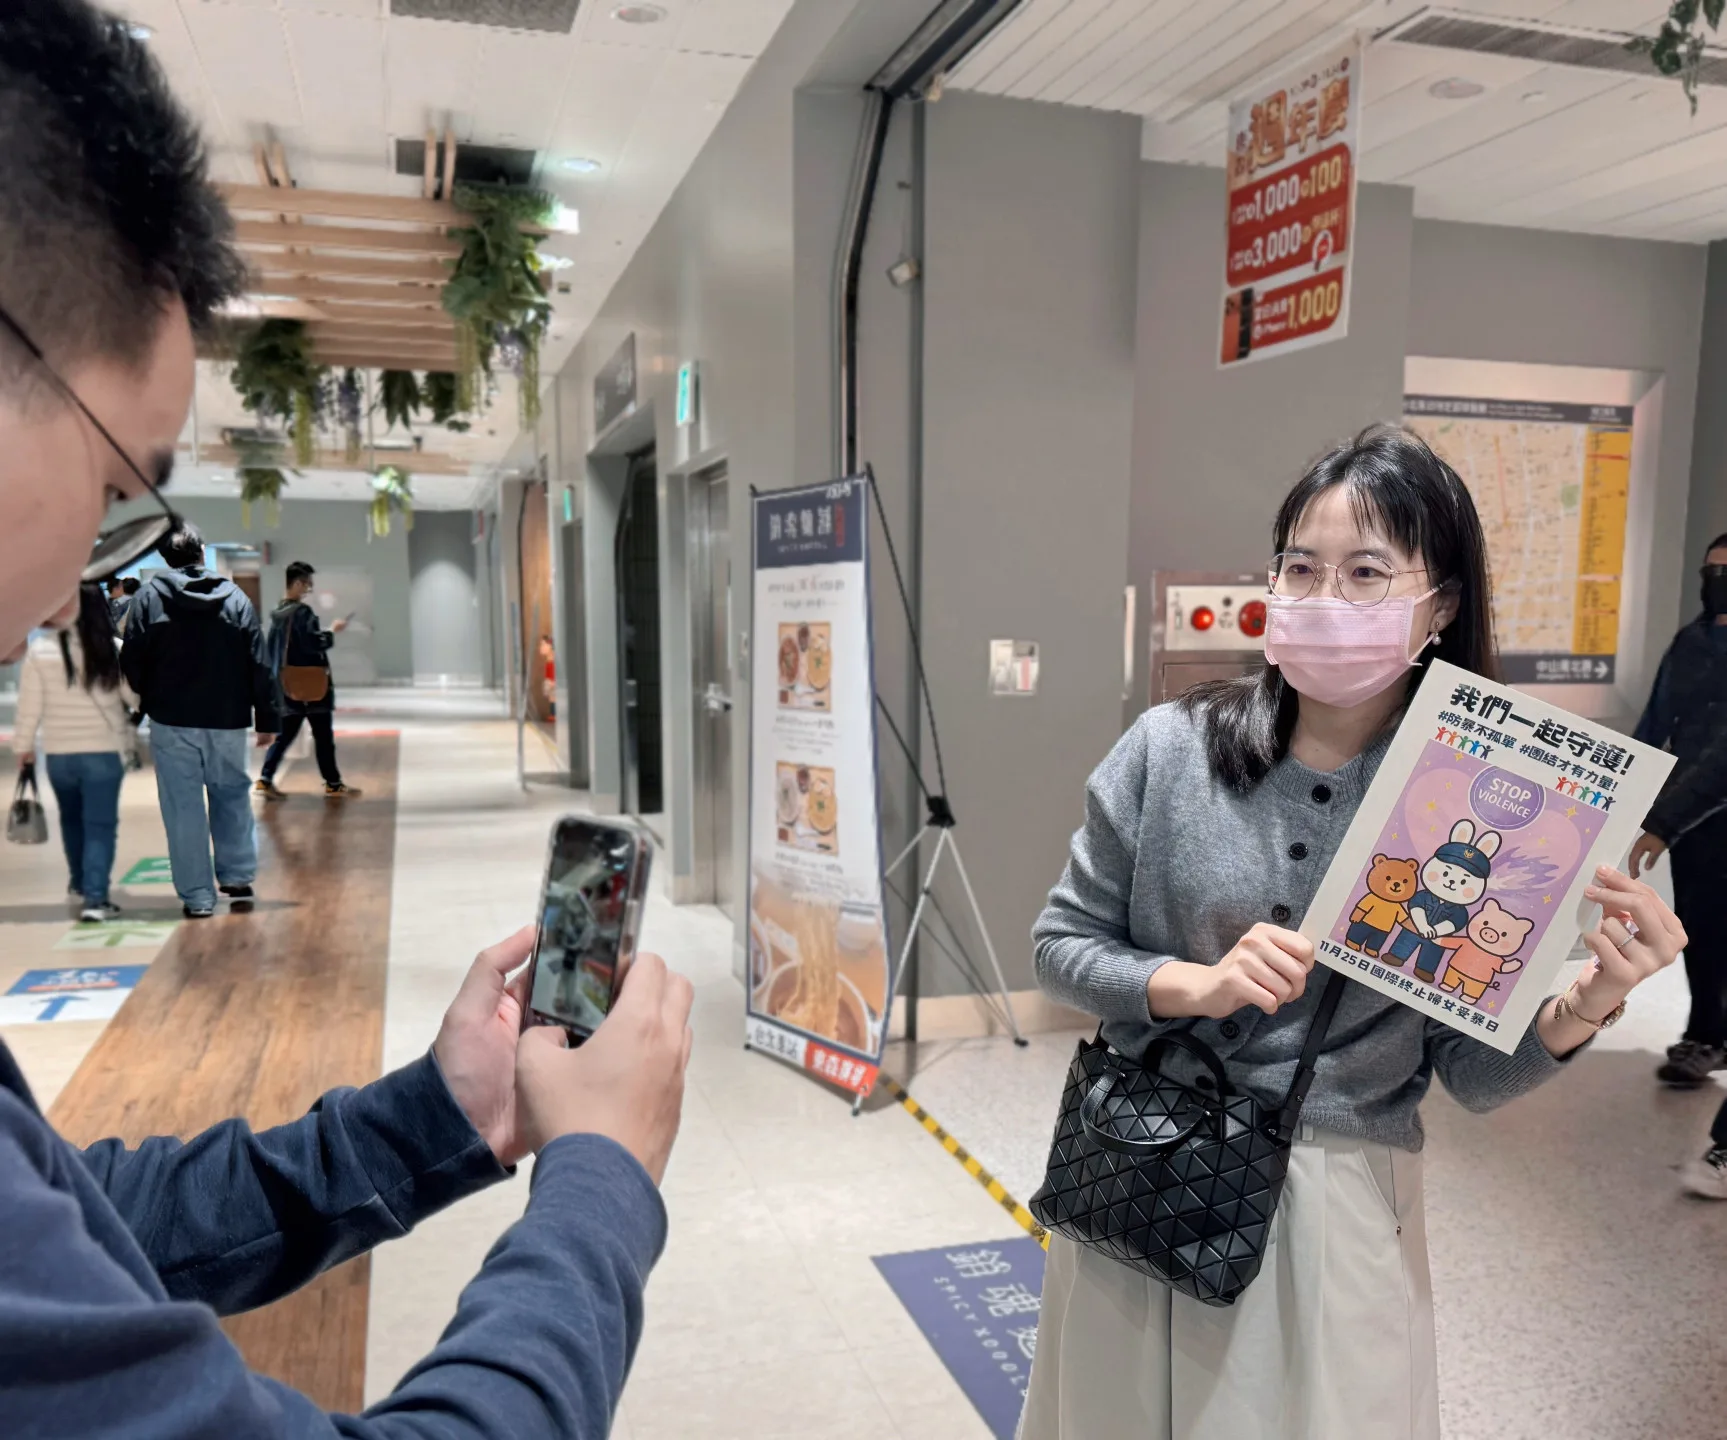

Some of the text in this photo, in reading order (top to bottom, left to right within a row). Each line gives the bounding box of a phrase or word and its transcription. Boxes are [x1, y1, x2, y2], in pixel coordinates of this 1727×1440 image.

[1288, 280, 1339, 329] 1,000
[1438, 710, 1619, 792] #防暴不孤單 #團結才有力量!
[1450, 684, 1635, 776] 我們一起守護!
[1478, 790, 1531, 819] VIOLENCE
[1489, 778, 1532, 802] STOP
[1319, 940, 1500, 1033] 11月25日國際終止婦女受暴日
